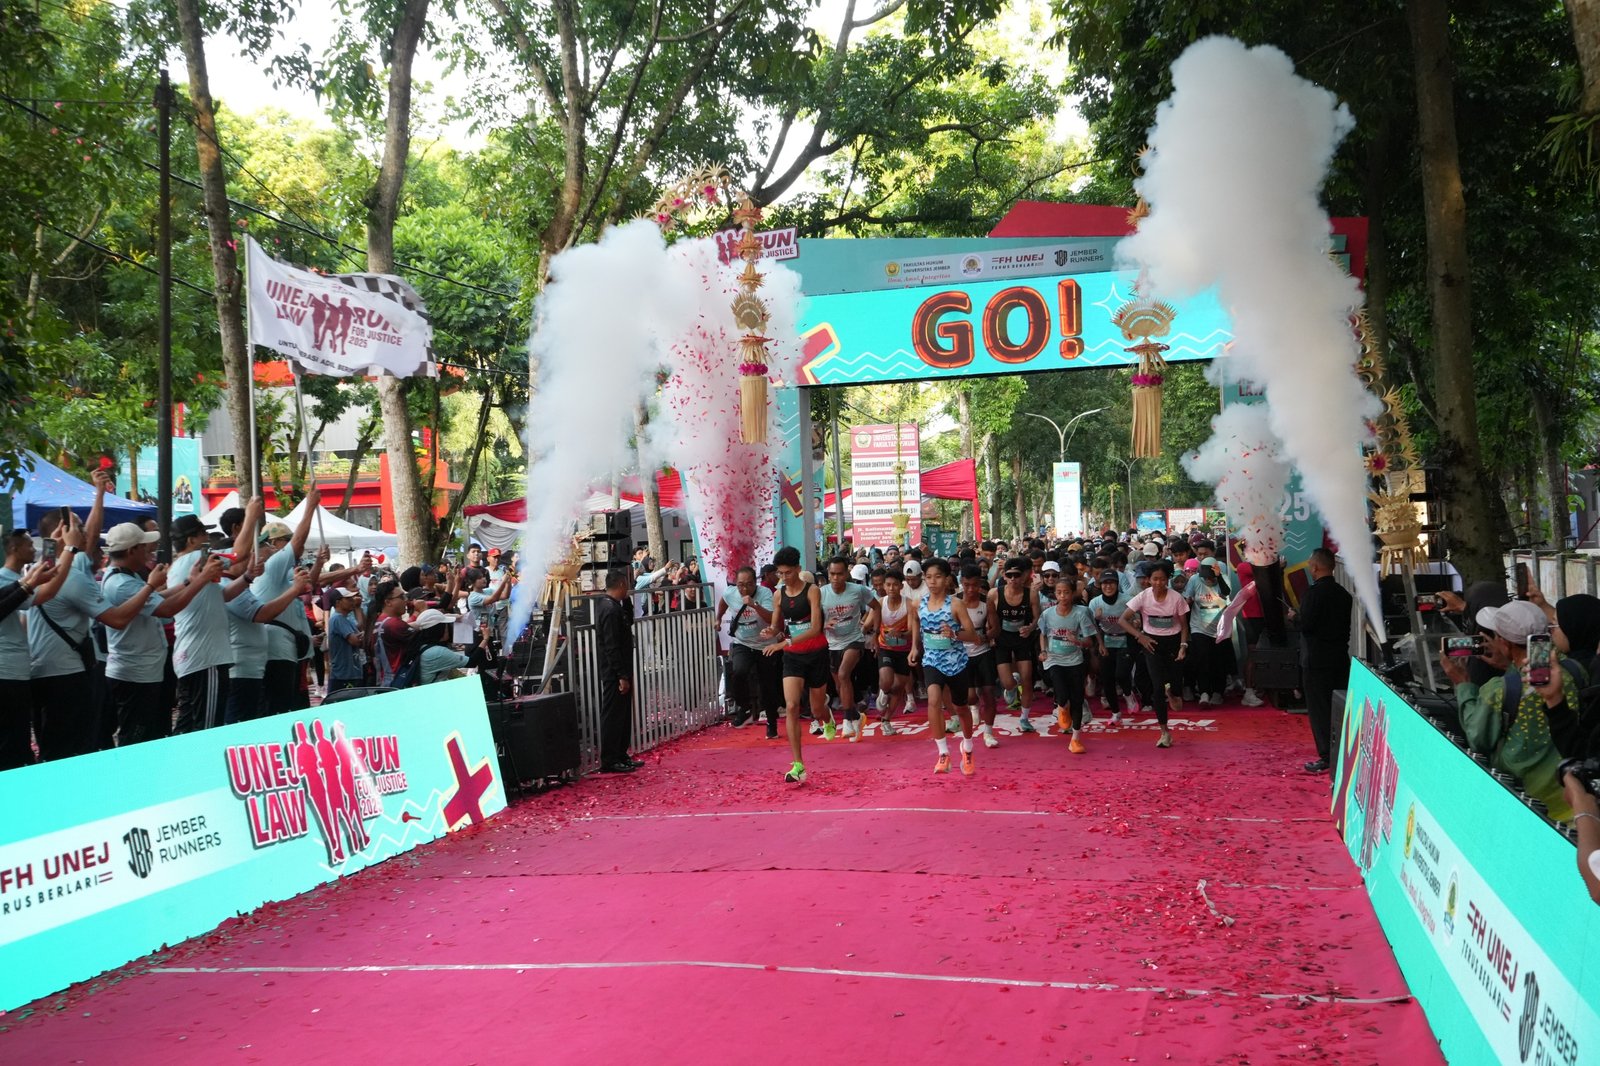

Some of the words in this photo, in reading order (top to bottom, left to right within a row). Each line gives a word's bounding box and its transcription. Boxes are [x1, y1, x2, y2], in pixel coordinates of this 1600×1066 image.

[766, 248, 795, 258] JUSTICE
[999, 256, 1013, 264] FH
[1015, 253, 1045, 263] UNEJ
[1070, 248, 1098, 257] JEMBER
[1070, 254, 1104, 263] RUNNERS
[903, 266, 933, 274] UNIVERSITAS
[922, 273, 951, 281] Integritas
[266, 279, 312, 309] UNEJ
[275, 303, 308, 327] LAW
[912, 278, 1084, 369] GO!
[347, 335, 369, 349] 2025
[351, 325, 366, 338] FOR
[366, 329, 403, 347] JUSTICE
[319, 357, 336, 370] ADIL
[876, 508, 893, 516] SARJANA
[930, 533, 937, 544] 6
[943, 538, 952, 550] 7
[352, 734, 400, 775] RUN
[225, 742, 302, 798] UNEJ
[376, 772, 408, 793] JUSTICE
[156, 815, 208, 844] JEMBER
[247, 788, 308, 850] LAW
[159, 831, 222, 864] RUNNERS
[0, 863, 34, 895] FH
[44, 841, 110, 880] UNEJ
[38, 874, 98, 904] BERLARI
[1471, 908, 1488, 950] FH
[1487, 927, 1518, 993] UNEJ
[1461, 938, 1479, 973] TERUS
[1479, 965, 1505, 1011] BERLARI
[1539, 1001, 1578, 1066] JEMBER
